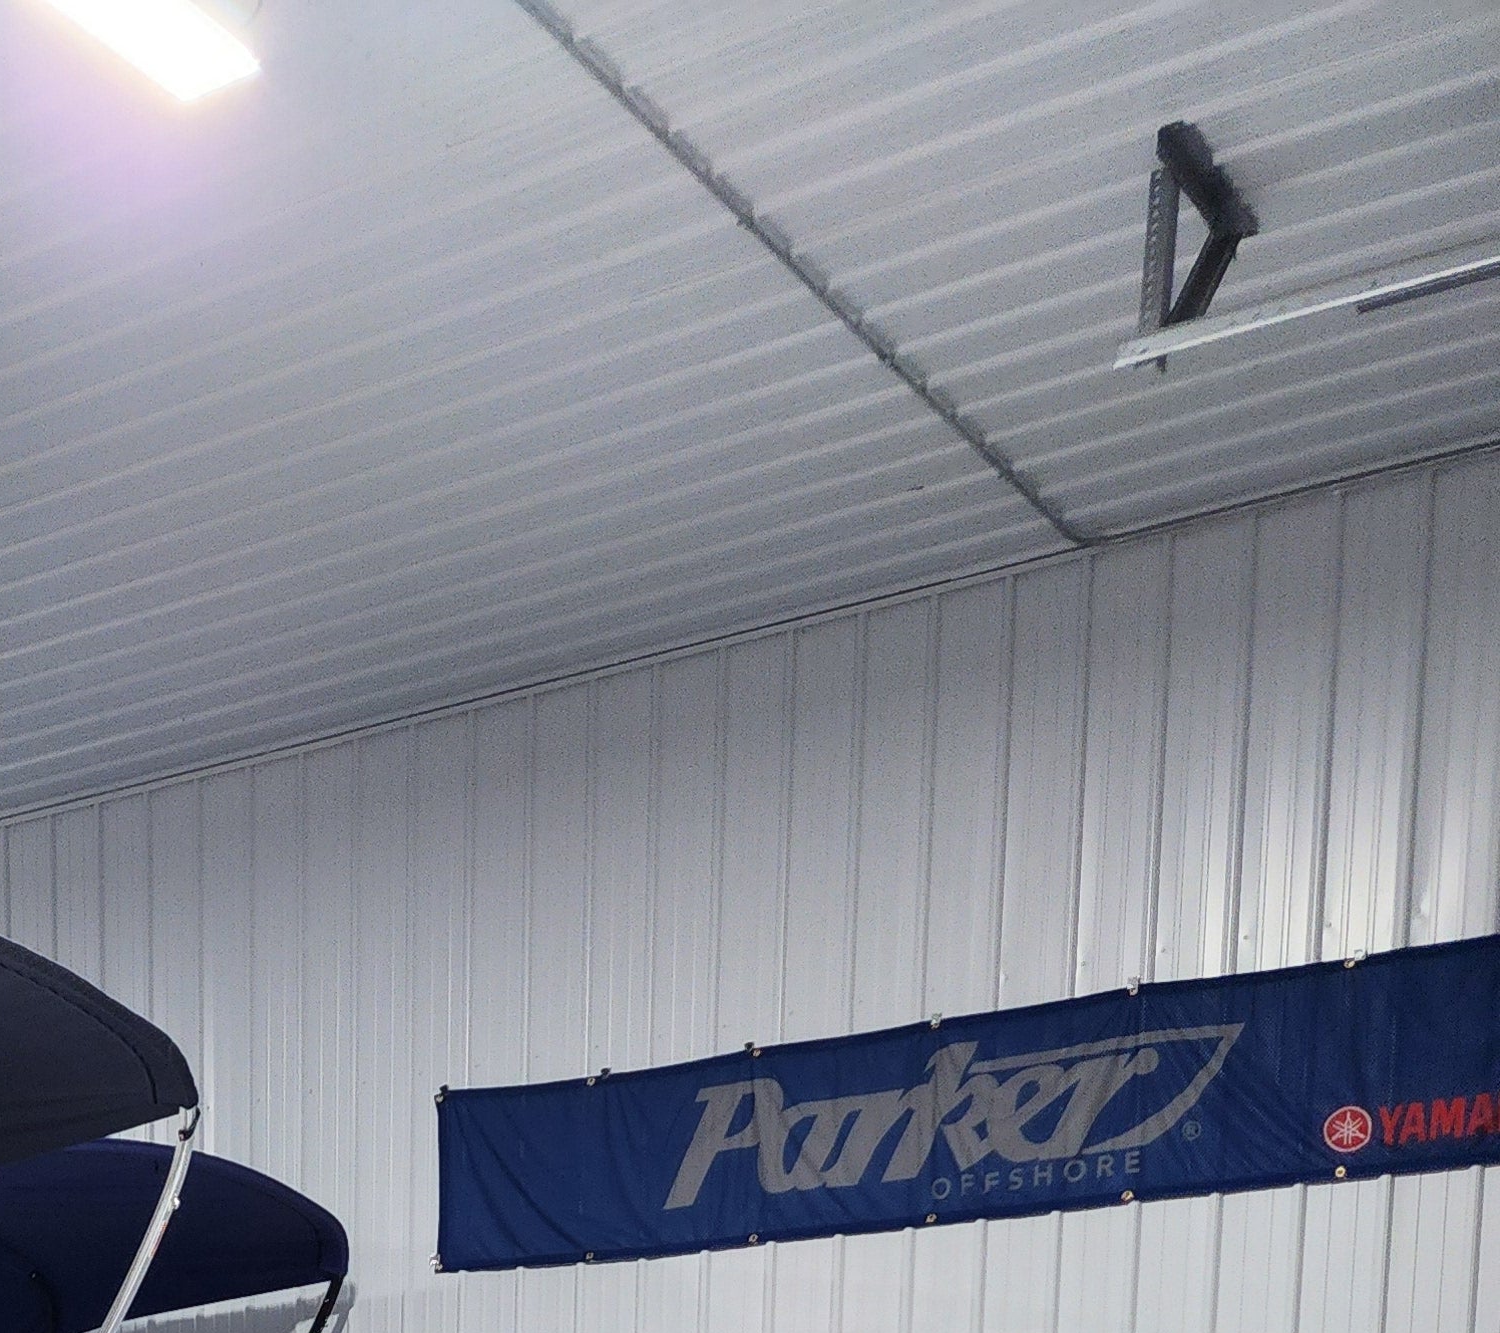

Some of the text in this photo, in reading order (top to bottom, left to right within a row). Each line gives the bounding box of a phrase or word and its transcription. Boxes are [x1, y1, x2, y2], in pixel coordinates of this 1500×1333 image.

[663, 1040, 1160, 1210] Parker
[1379, 1092, 1500, 1146] YAMA
[931, 1150, 1142, 1200] OFFSHORE
